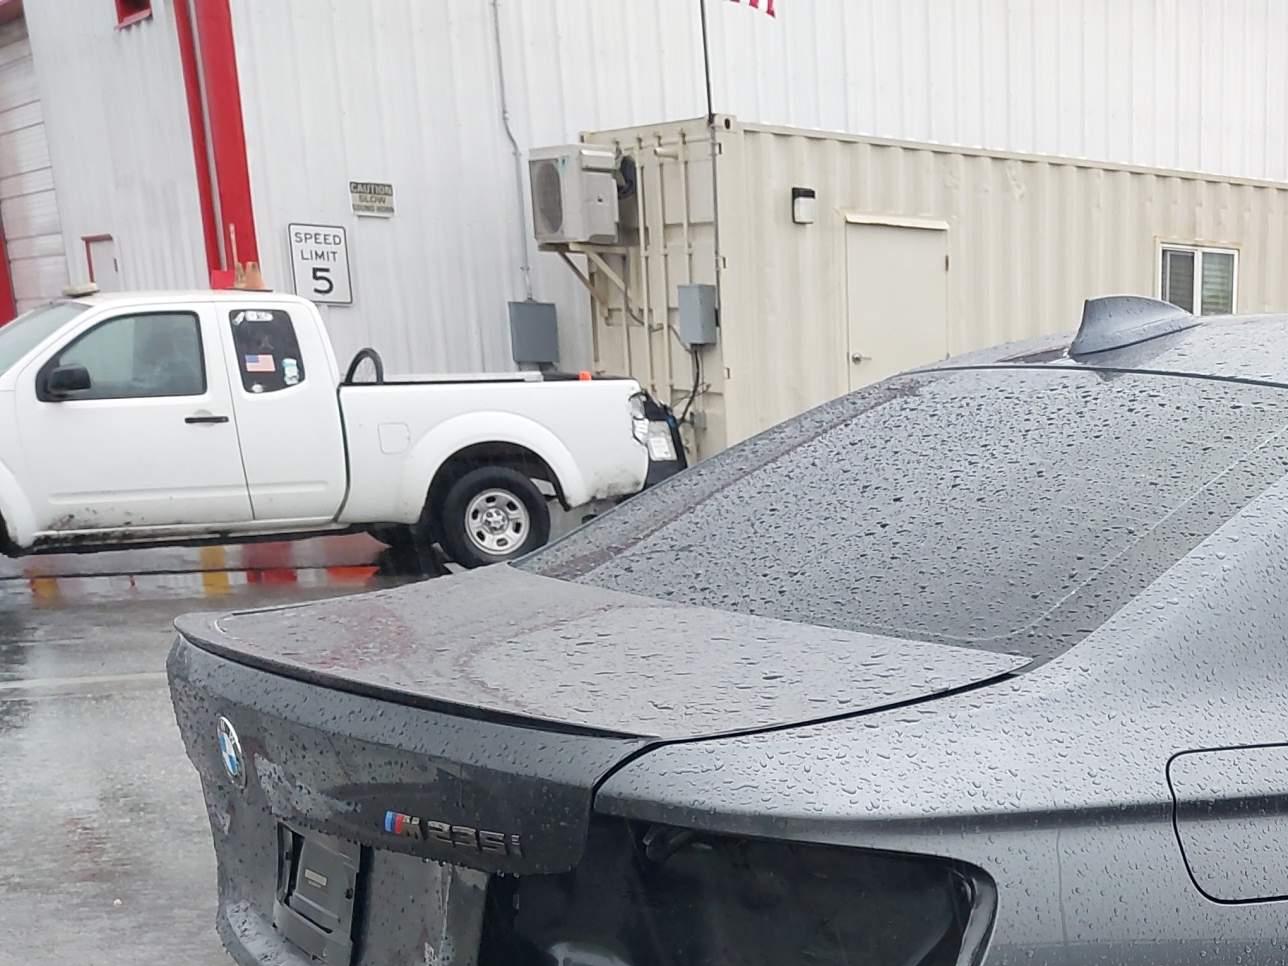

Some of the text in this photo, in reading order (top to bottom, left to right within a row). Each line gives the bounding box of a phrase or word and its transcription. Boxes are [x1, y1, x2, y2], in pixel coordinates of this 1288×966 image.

[350, 182, 393, 196] CAUTION
[294, 231, 342, 246] SPEED
[300, 249, 338, 262] LIMIT
[312, 267, 334, 294] 5
